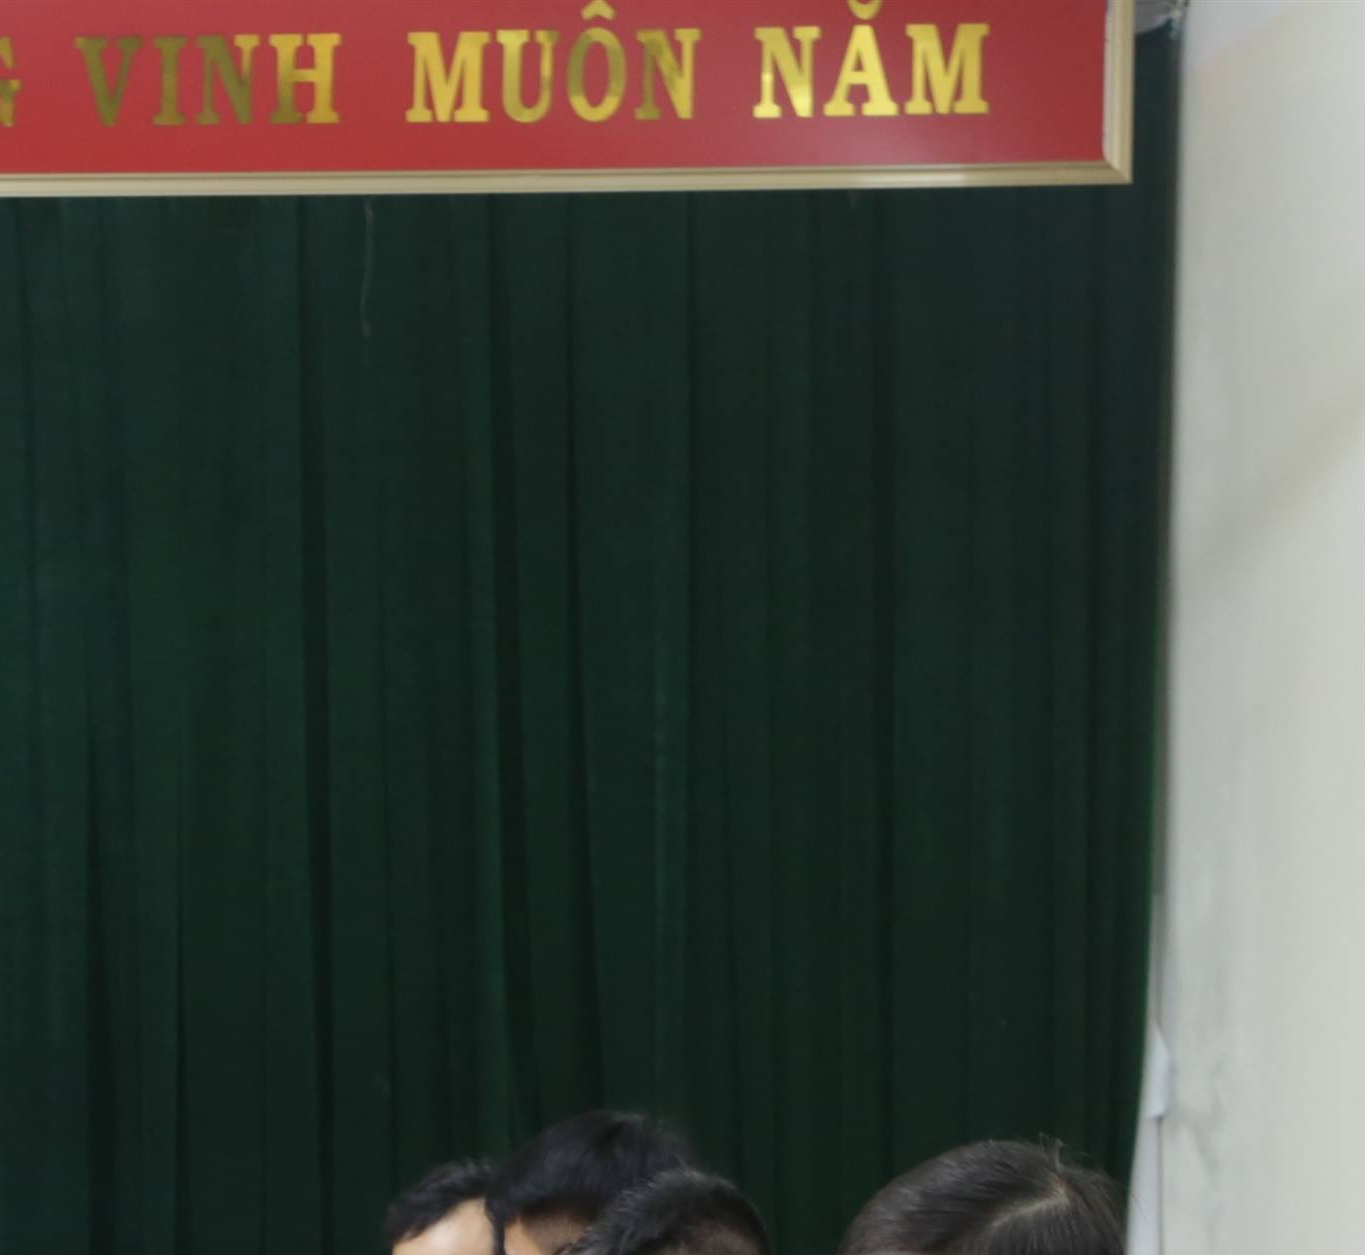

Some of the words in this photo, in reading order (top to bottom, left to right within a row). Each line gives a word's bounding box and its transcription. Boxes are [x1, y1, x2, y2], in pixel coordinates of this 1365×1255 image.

[74, 32, 342, 127] VINH
[405, 0, 702, 124] MUÔN
[751, 0, 991, 120] NĂM
